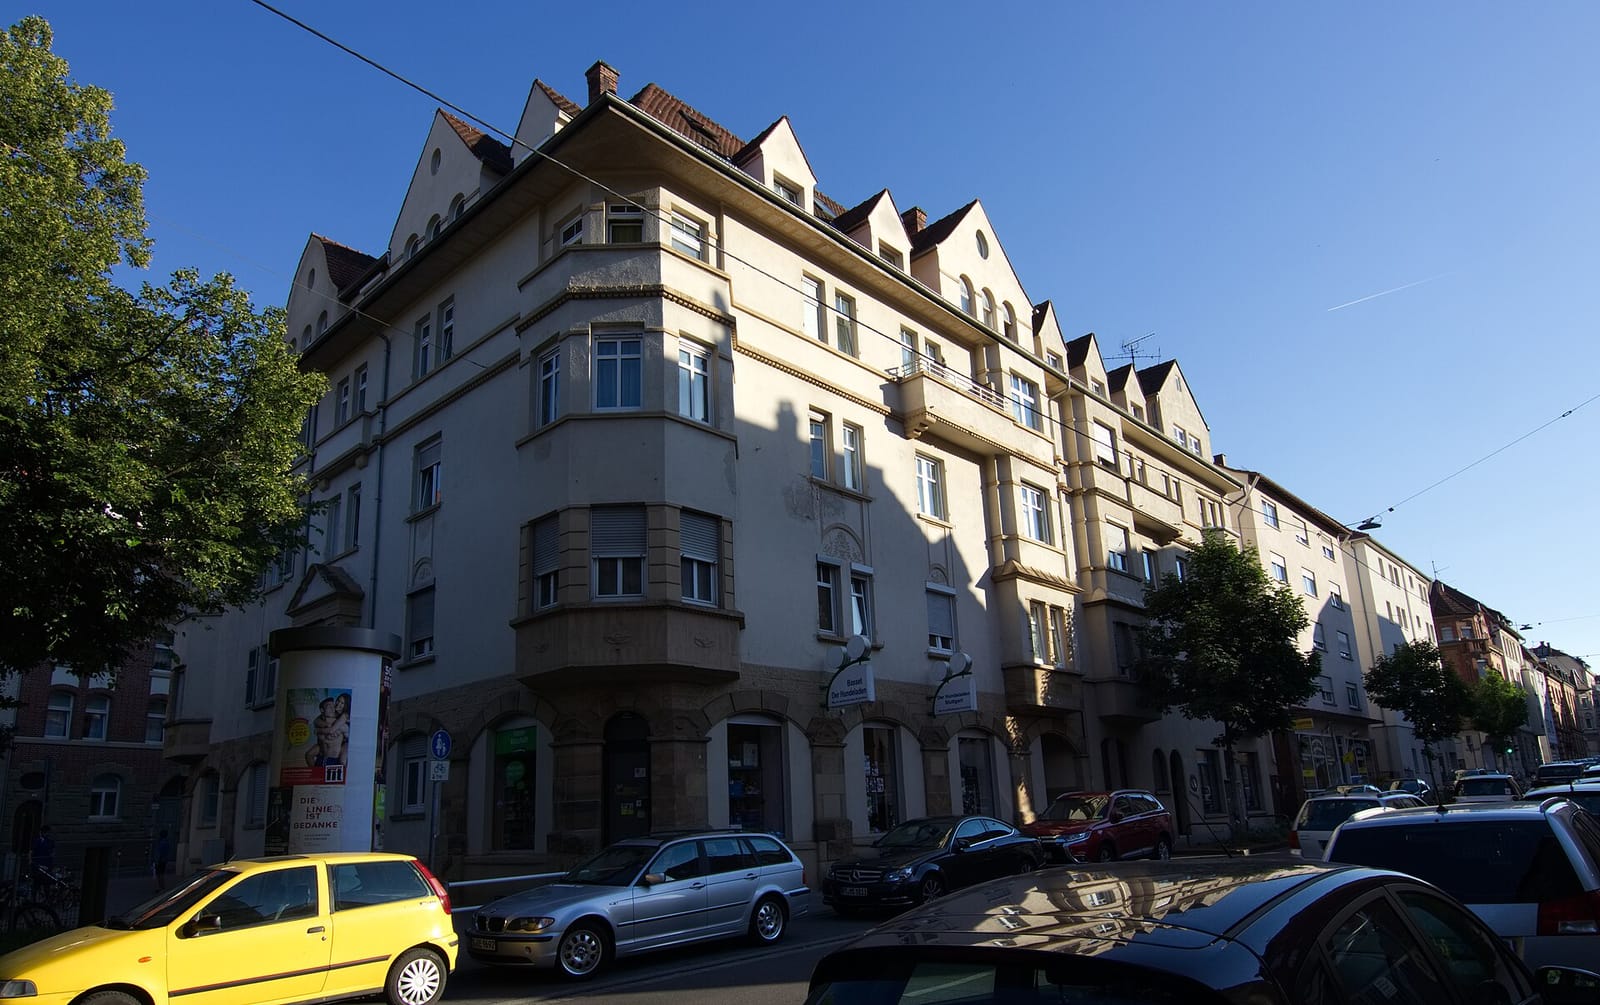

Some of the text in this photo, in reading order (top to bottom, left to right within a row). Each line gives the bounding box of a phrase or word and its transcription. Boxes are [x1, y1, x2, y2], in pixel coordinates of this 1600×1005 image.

[306, 805, 333, 813] LINIE
[306, 812, 320, 820] IST
[293, 821, 338, 829] GEDANKE
